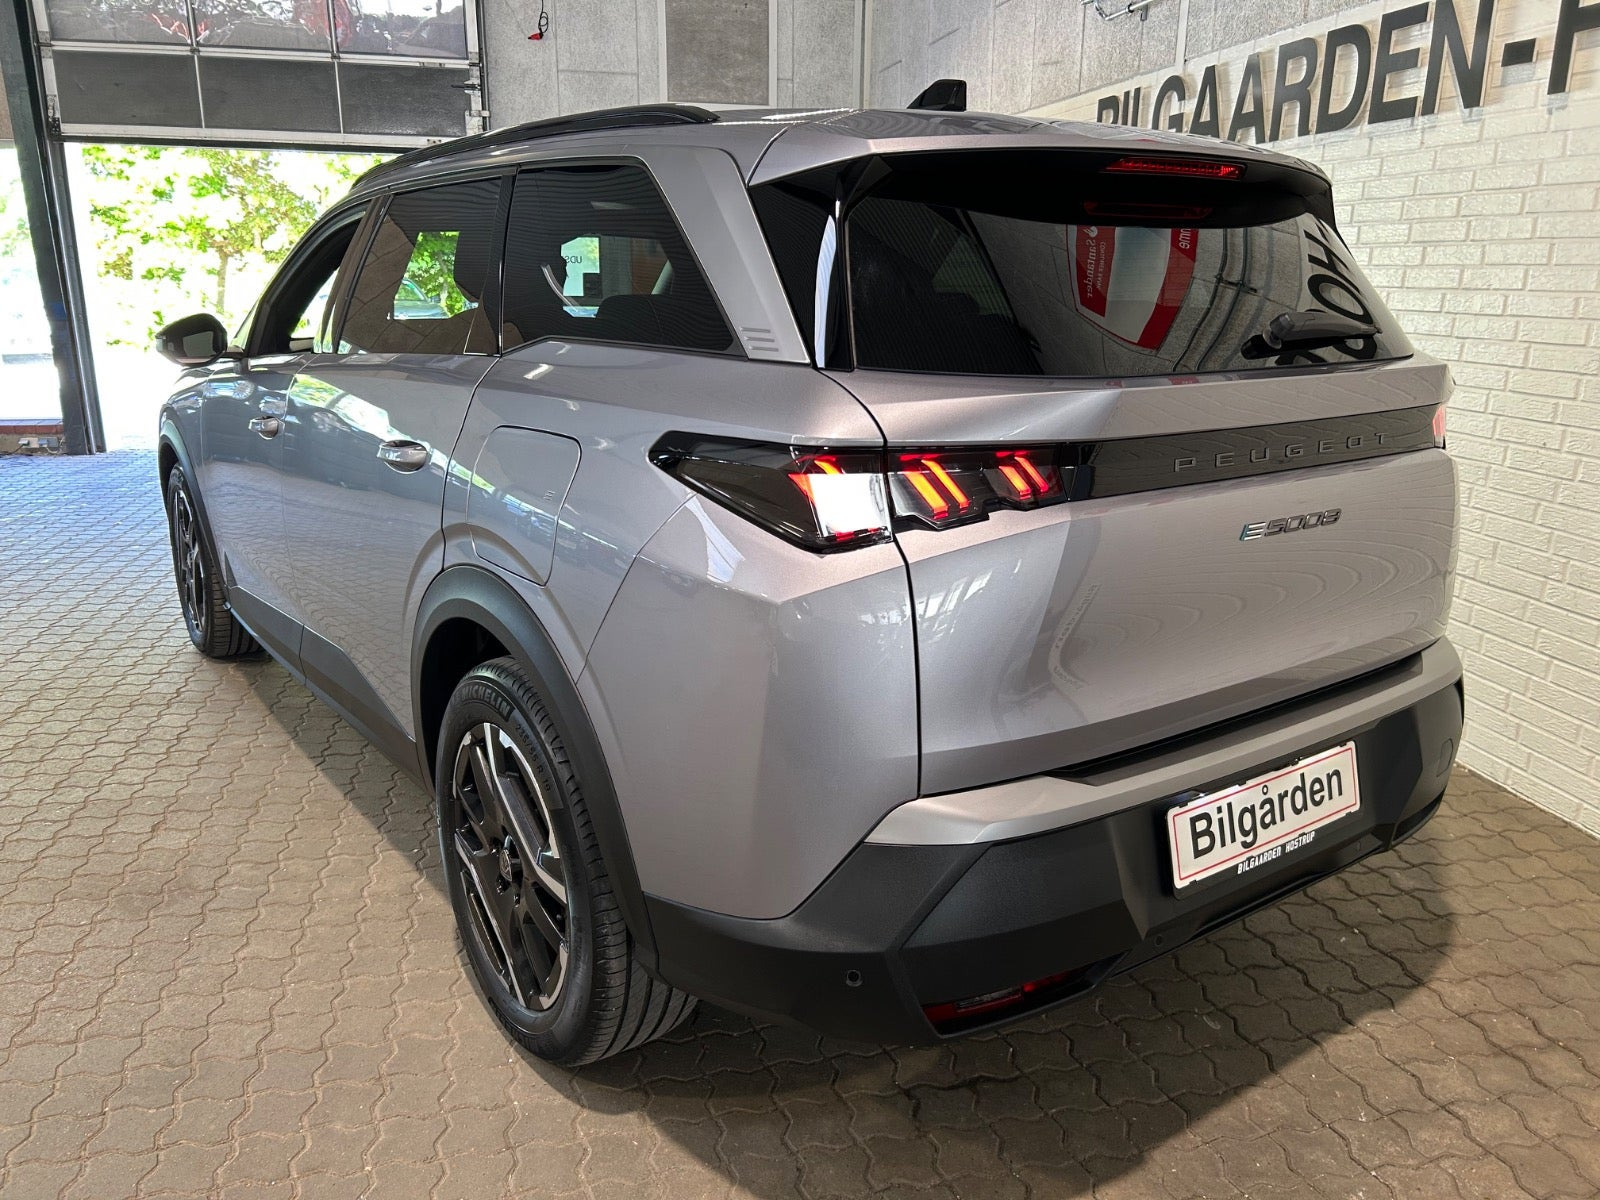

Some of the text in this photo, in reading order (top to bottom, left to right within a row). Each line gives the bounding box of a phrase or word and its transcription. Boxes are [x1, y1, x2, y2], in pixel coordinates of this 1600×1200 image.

[1173, 432, 1388, 473] PEUGEOT
[461, 685, 511, 717] MICHELIN
[1190, 769, 1343, 859] Bilgården
[1237, 846, 1282, 874] BILGAARDEN
